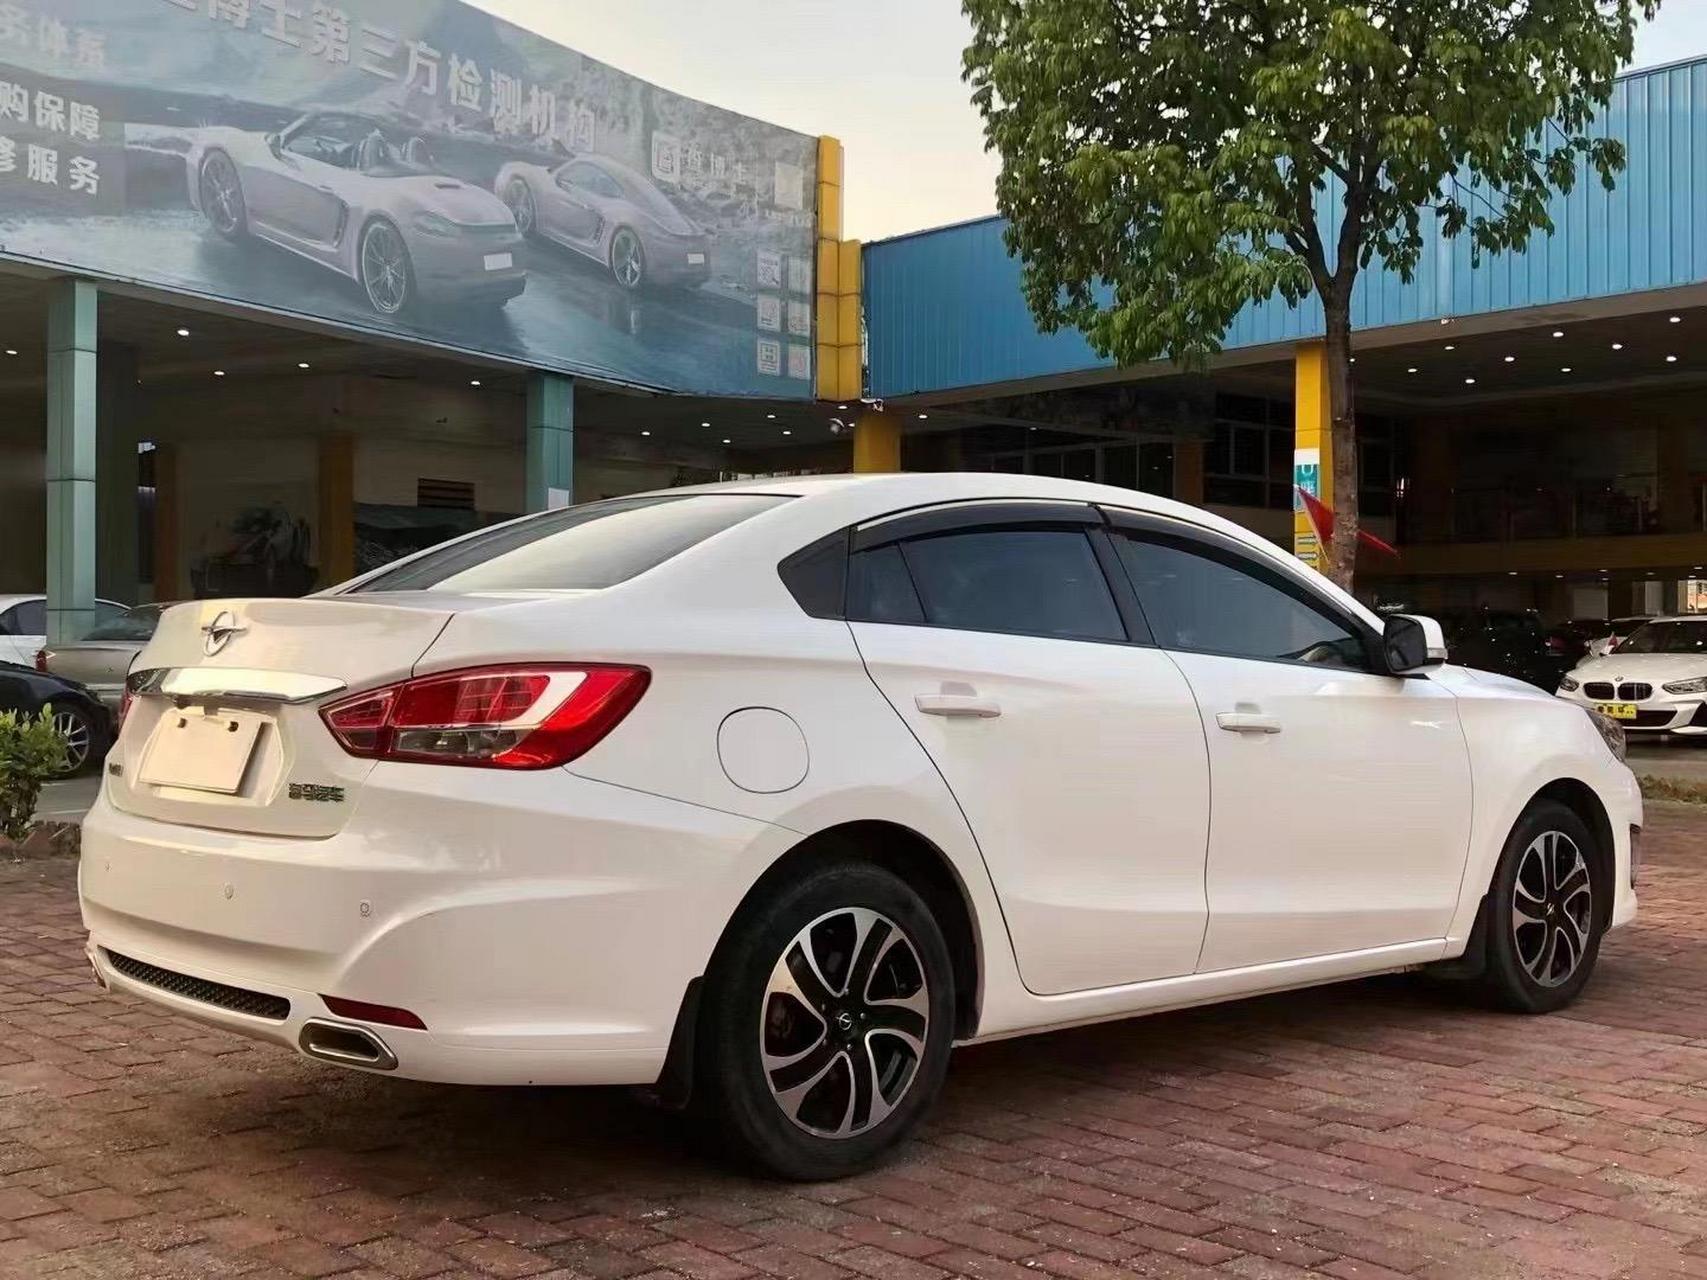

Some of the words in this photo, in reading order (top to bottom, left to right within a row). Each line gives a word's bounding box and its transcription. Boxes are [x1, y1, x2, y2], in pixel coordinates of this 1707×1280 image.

[0, 81, 100, 140] 购保障
[164, 0, 596, 153] 博士第三方检测机构
